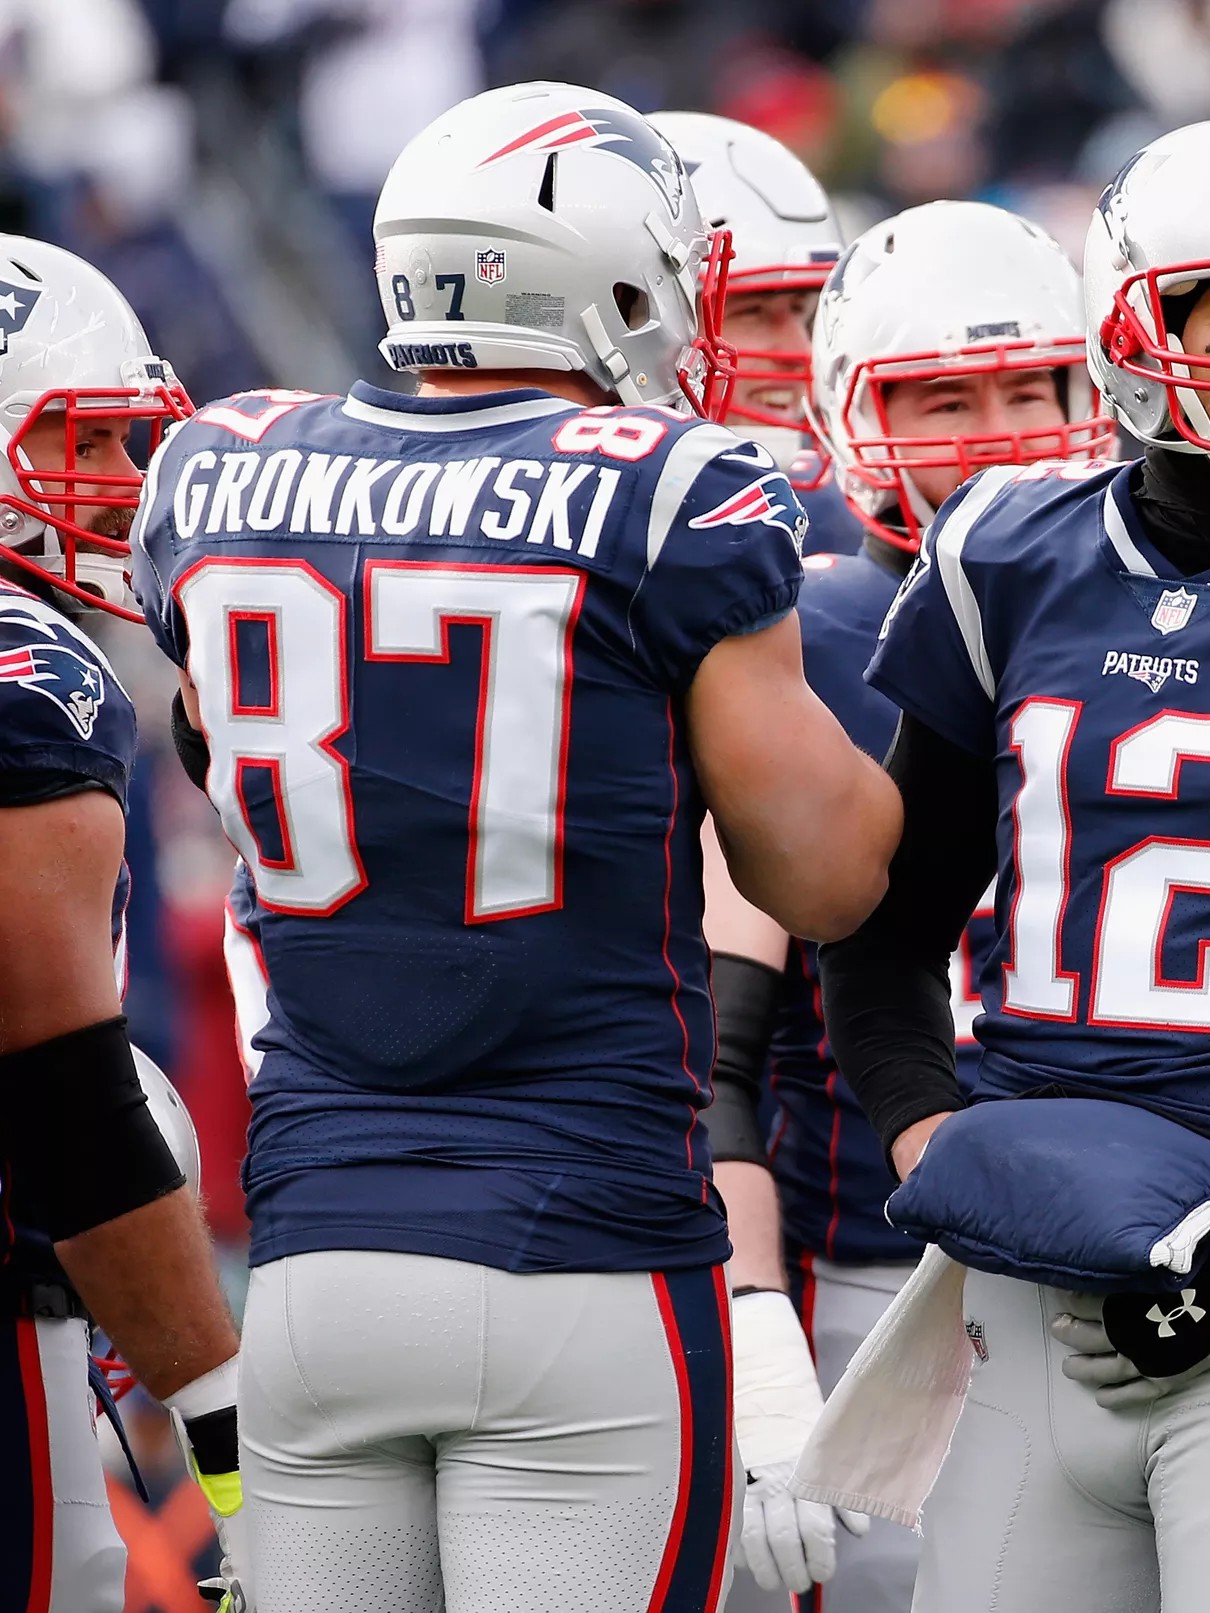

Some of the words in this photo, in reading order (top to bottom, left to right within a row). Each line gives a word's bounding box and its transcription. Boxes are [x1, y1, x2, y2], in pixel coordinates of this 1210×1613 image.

[479, 264, 503, 279] NFL
[386, 342, 478, 369] PATRIOTS
[173, 449, 621, 559] GRONKOWSKI
[1158, 607, 1183, 625] NFL
[1101, 651, 1200, 685] PATRIOTS
[171, 555, 587, 925] 87
